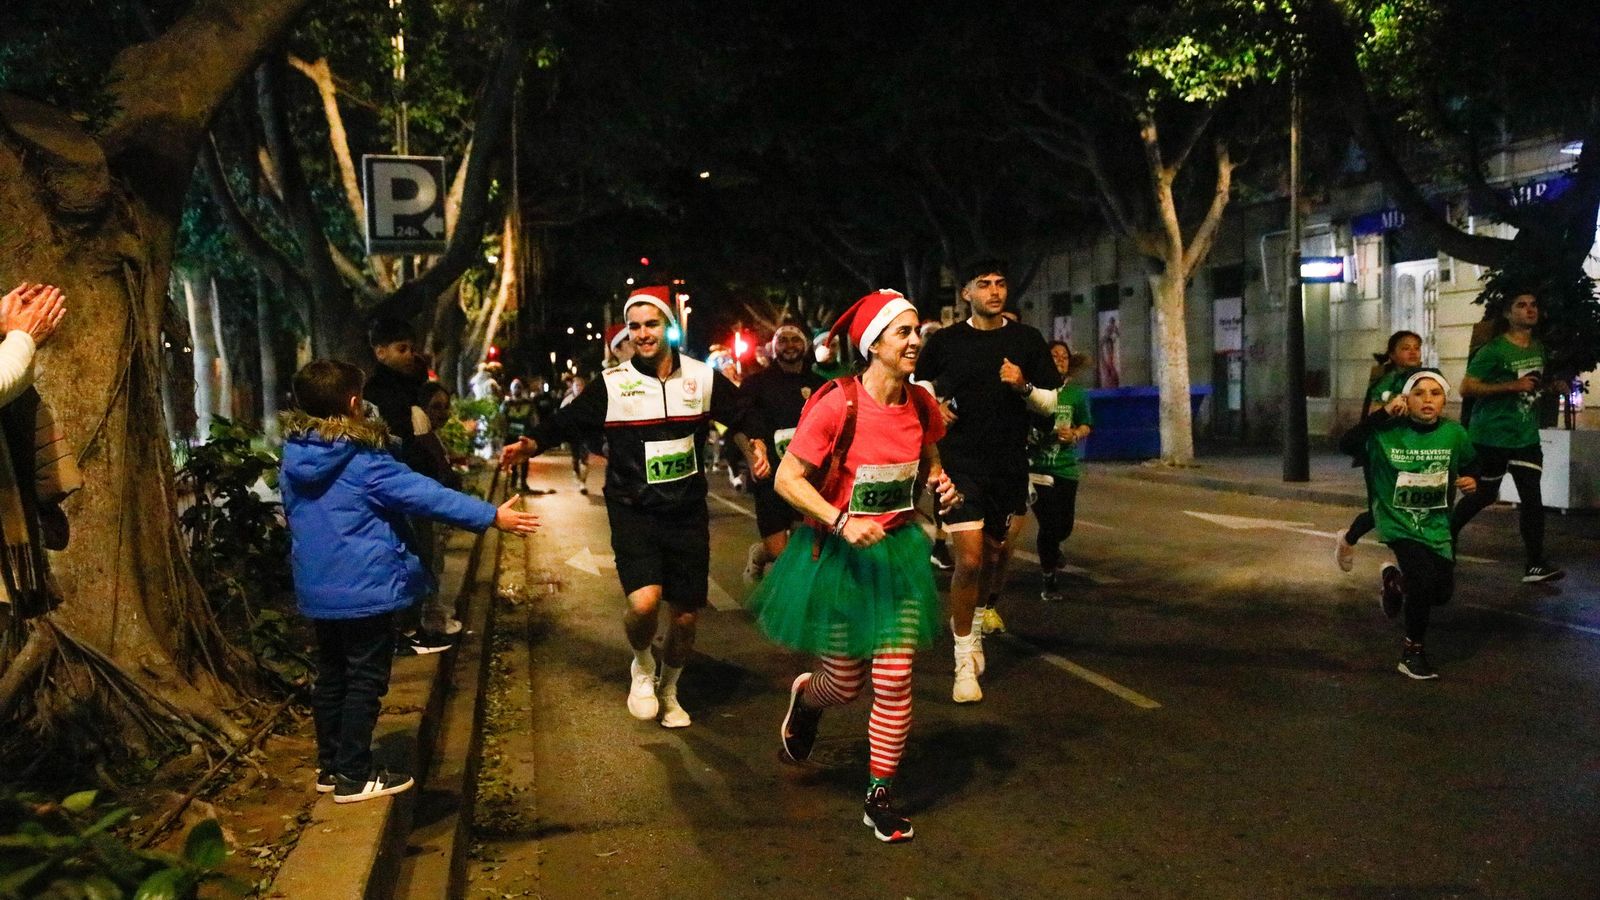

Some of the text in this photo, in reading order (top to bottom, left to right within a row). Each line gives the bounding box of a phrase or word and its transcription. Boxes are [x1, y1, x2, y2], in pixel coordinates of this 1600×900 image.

[372, 162, 437, 237] P
[1420, 448, 1452, 456] SILVESTRE
[1391, 453, 1415, 461] CIUDAD
